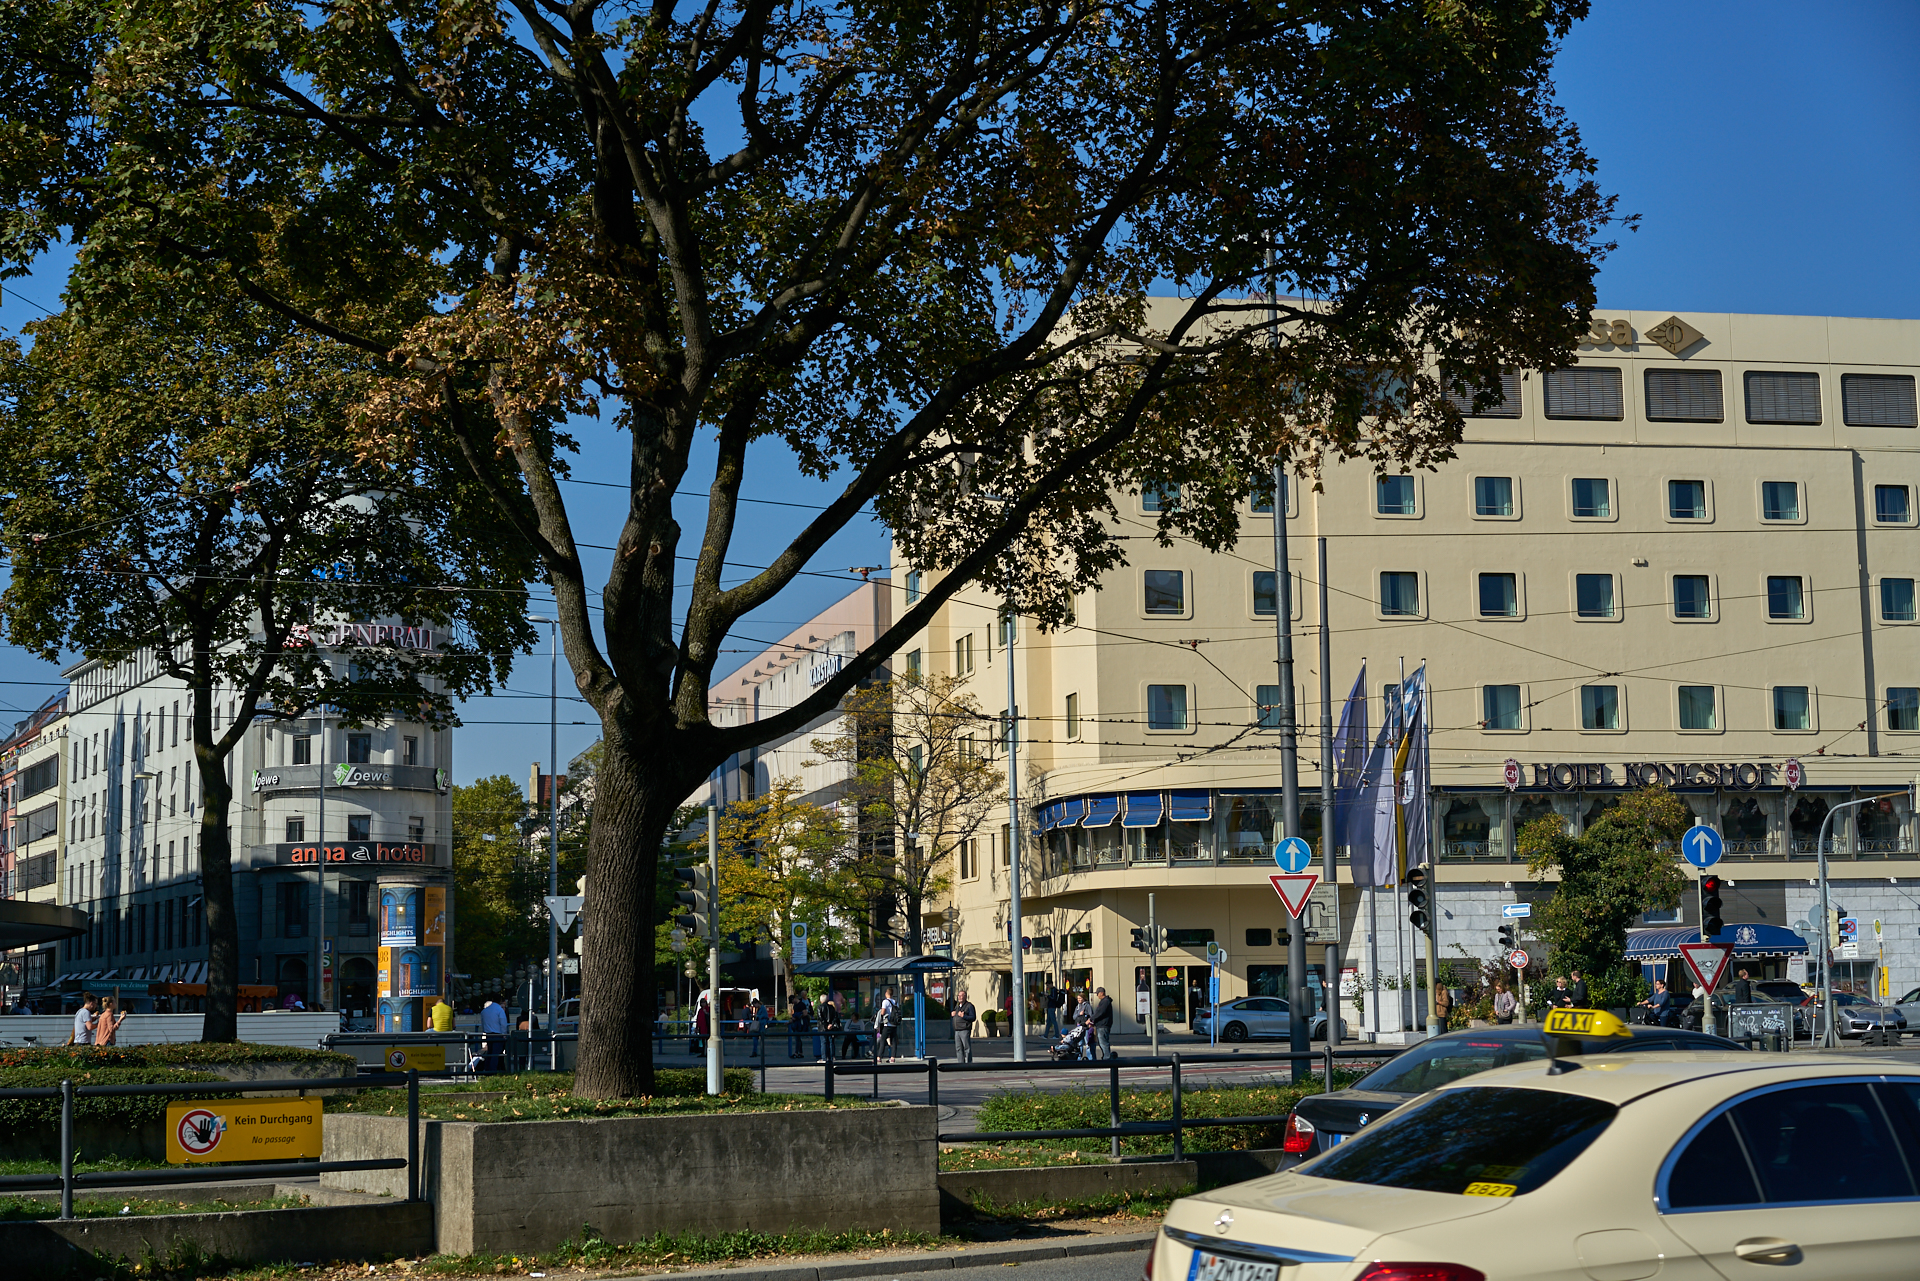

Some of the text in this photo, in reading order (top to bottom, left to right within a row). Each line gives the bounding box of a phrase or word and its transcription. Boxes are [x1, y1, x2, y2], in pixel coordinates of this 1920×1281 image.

[323, 624, 434, 650] GENERALI
[810, 655, 841, 686] KARSTADT
[253, 771, 279, 791] Loewe
[342, 767, 390, 786] Loewe
[1532, 762, 1772, 792] HOTEL KÖNIGSHOF
[291, 847, 345, 862] anna
[376, 843, 426, 862] hotel
[1553, 1013, 1593, 1031] TAXI
[234, 1114, 313, 1125] Kein Durchgang
[251, 1135, 296, 1145] No passage
[1467, 1184, 1514, 1197] 2827
